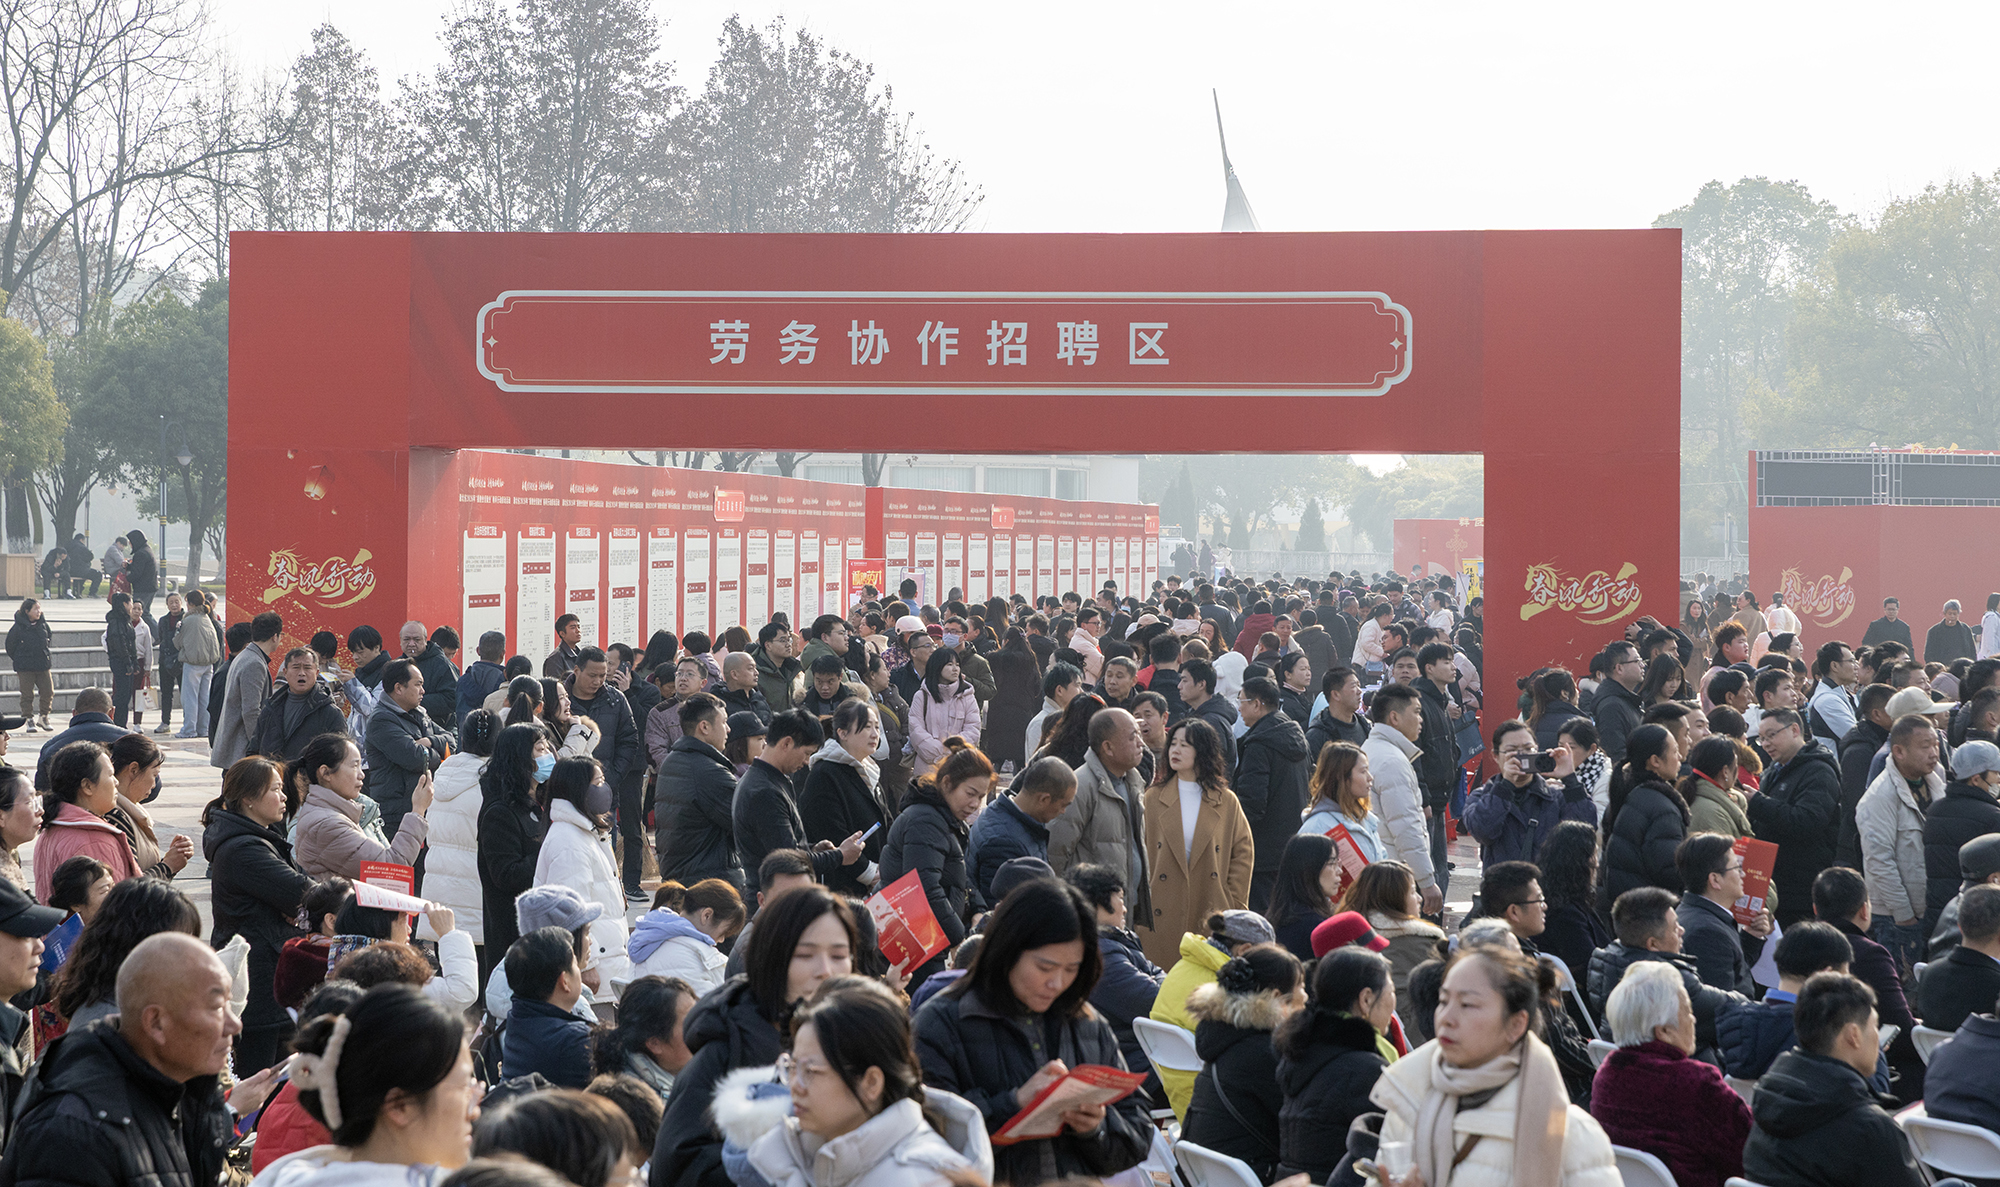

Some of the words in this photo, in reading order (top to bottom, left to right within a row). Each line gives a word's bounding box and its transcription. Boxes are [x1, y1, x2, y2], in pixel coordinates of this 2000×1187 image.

[709, 319, 1170, 367] 劳务协作招聘区
[269, 557, 375, 599] 春风行动
[1526, 572, 1640, 615] 春风行动
[1783, 578, 1855, 618] 春风行动
